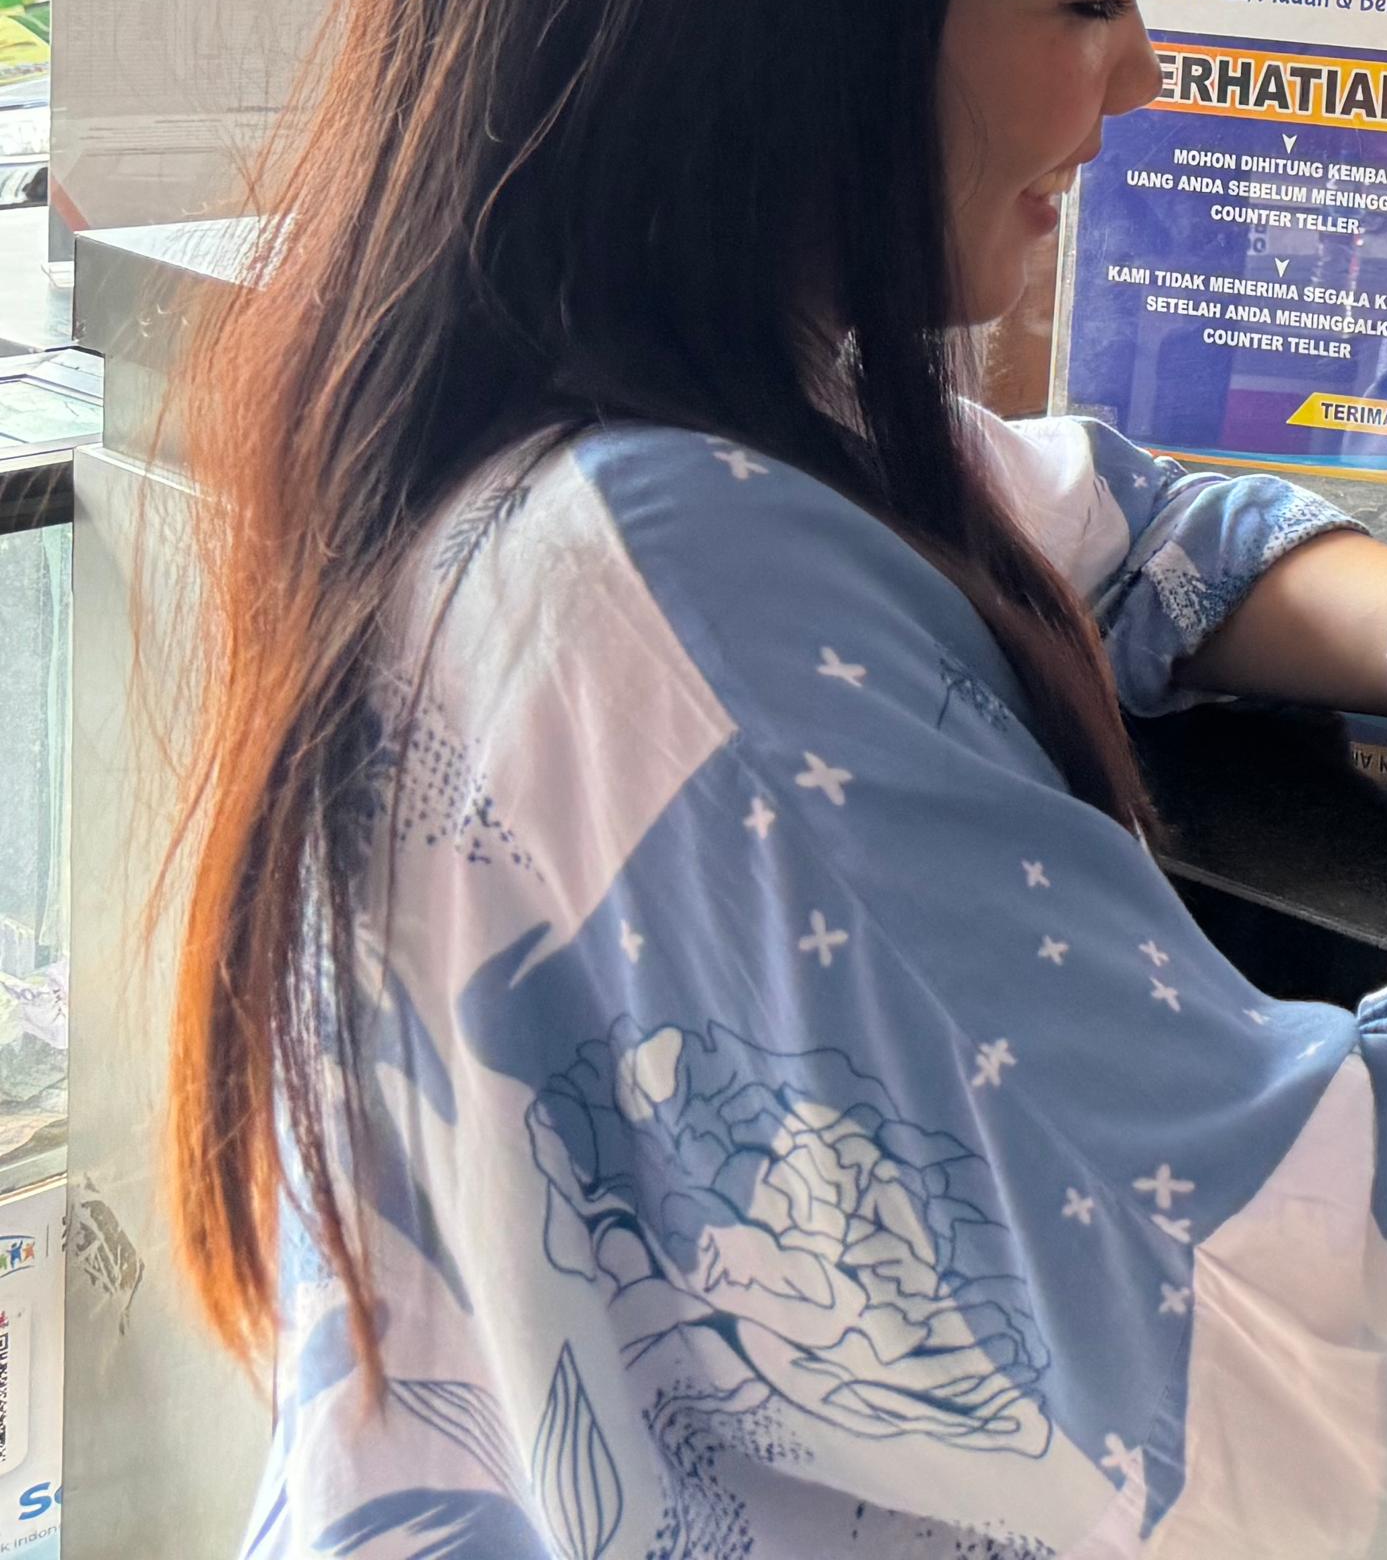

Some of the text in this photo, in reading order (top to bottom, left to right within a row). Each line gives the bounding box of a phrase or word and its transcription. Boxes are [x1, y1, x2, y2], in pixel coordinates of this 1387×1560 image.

[1174, 149, 1236, 169] MOHON
[1241, 154, 1323, 179] DIHITUNG
[1126, 170, 1174, 189] UANG
[1178, 175, 1224, 195] ANDA
[1228, 180, 1307, 203] SEBELUM
[1211, 205, 1292, 228] COUNTER
[1108, 266, 1150, 285] KAMI
[1155, 270, 1206, 290] TIDAK
[1209, 277, 1299, 301] MENERIMA
[1303, 286, 1370, 308] SEGALA
[1146, 296, 1220, 319] SETELAH
[1225, 304, 1271, 324] ANDA
[1203, 329, 1351, 359] COUNTER TELLER
